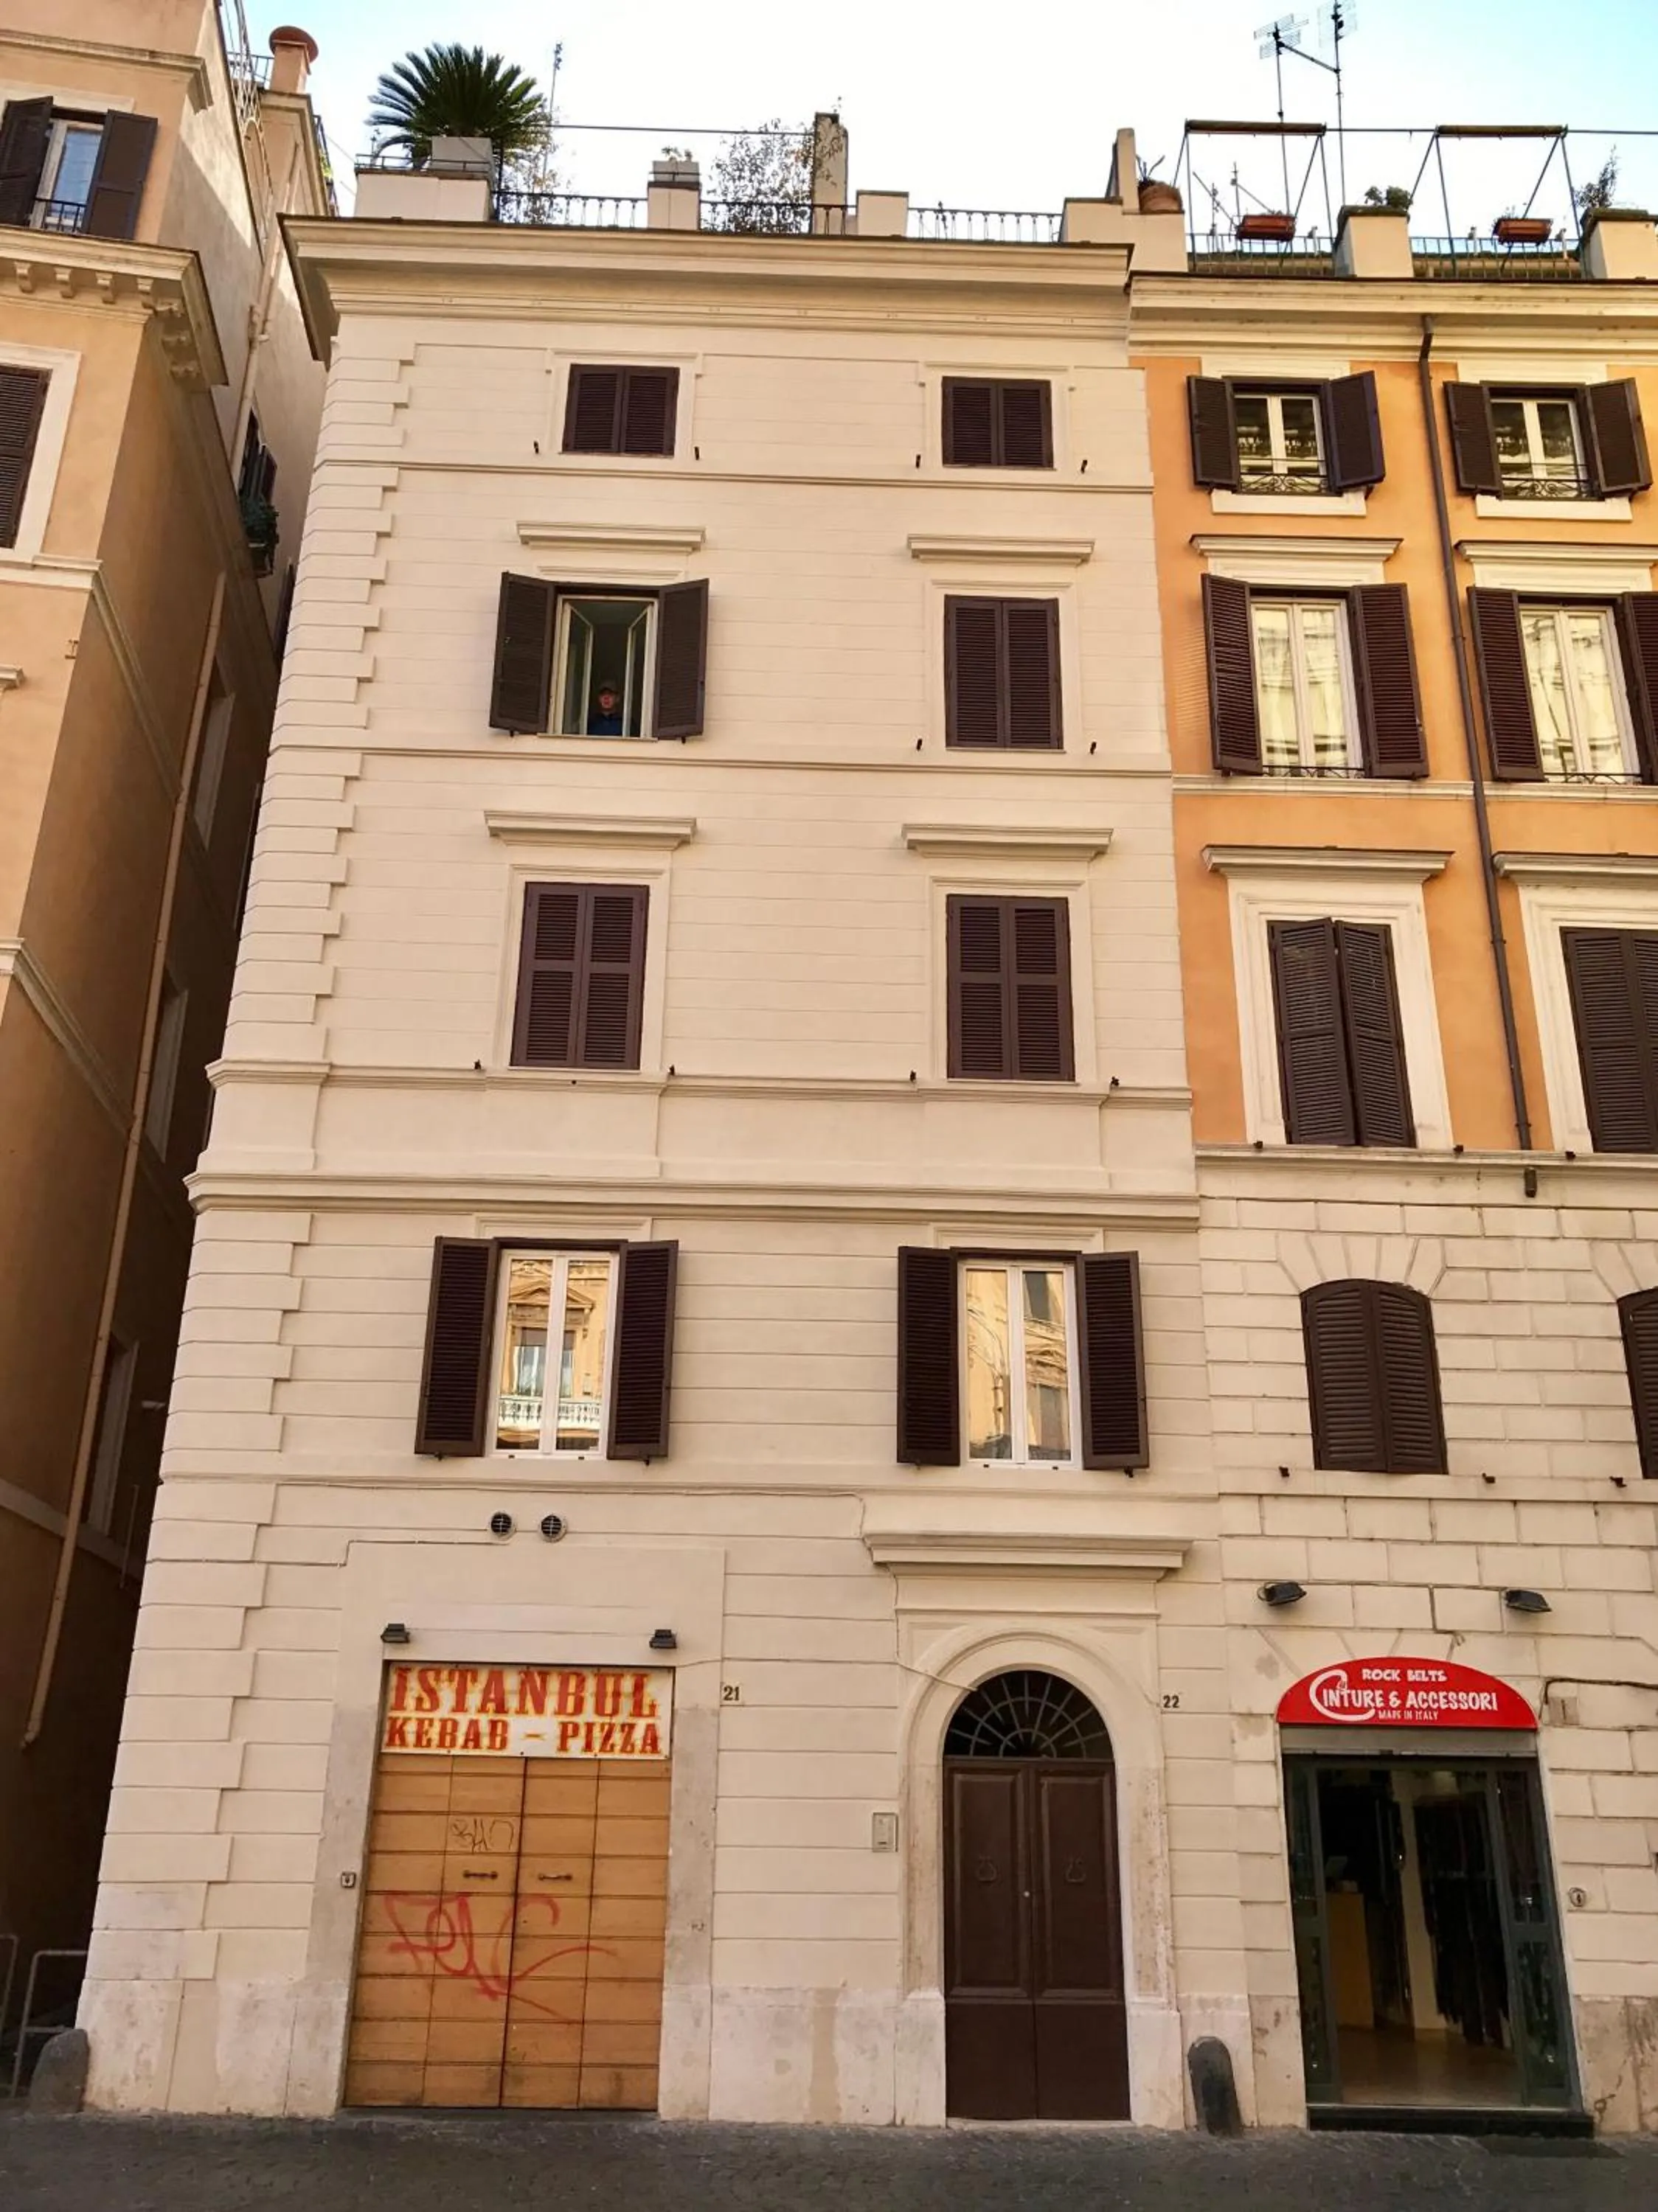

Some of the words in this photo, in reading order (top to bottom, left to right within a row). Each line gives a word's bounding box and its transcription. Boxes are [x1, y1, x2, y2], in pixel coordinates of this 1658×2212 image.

[1362, 1669, 1401, 1682] ROCK
[1406, 1669, 1447, 1682] BELTS
[724, 1685, 740, 1701] 21
[1309, 1669, 1384, 1722] CINTURE
[1389, 1691, 1401, 1708] &
[1406, 1690, 1498, 1711] ACCESSORI
[1163, 1694, 1180, 1708] 22
[1415, 1711, 1439, 1720] ITALY
[386, 1716, 509, 1750] KEBAB
[558, 1721, 662, 1754] PIZZA
